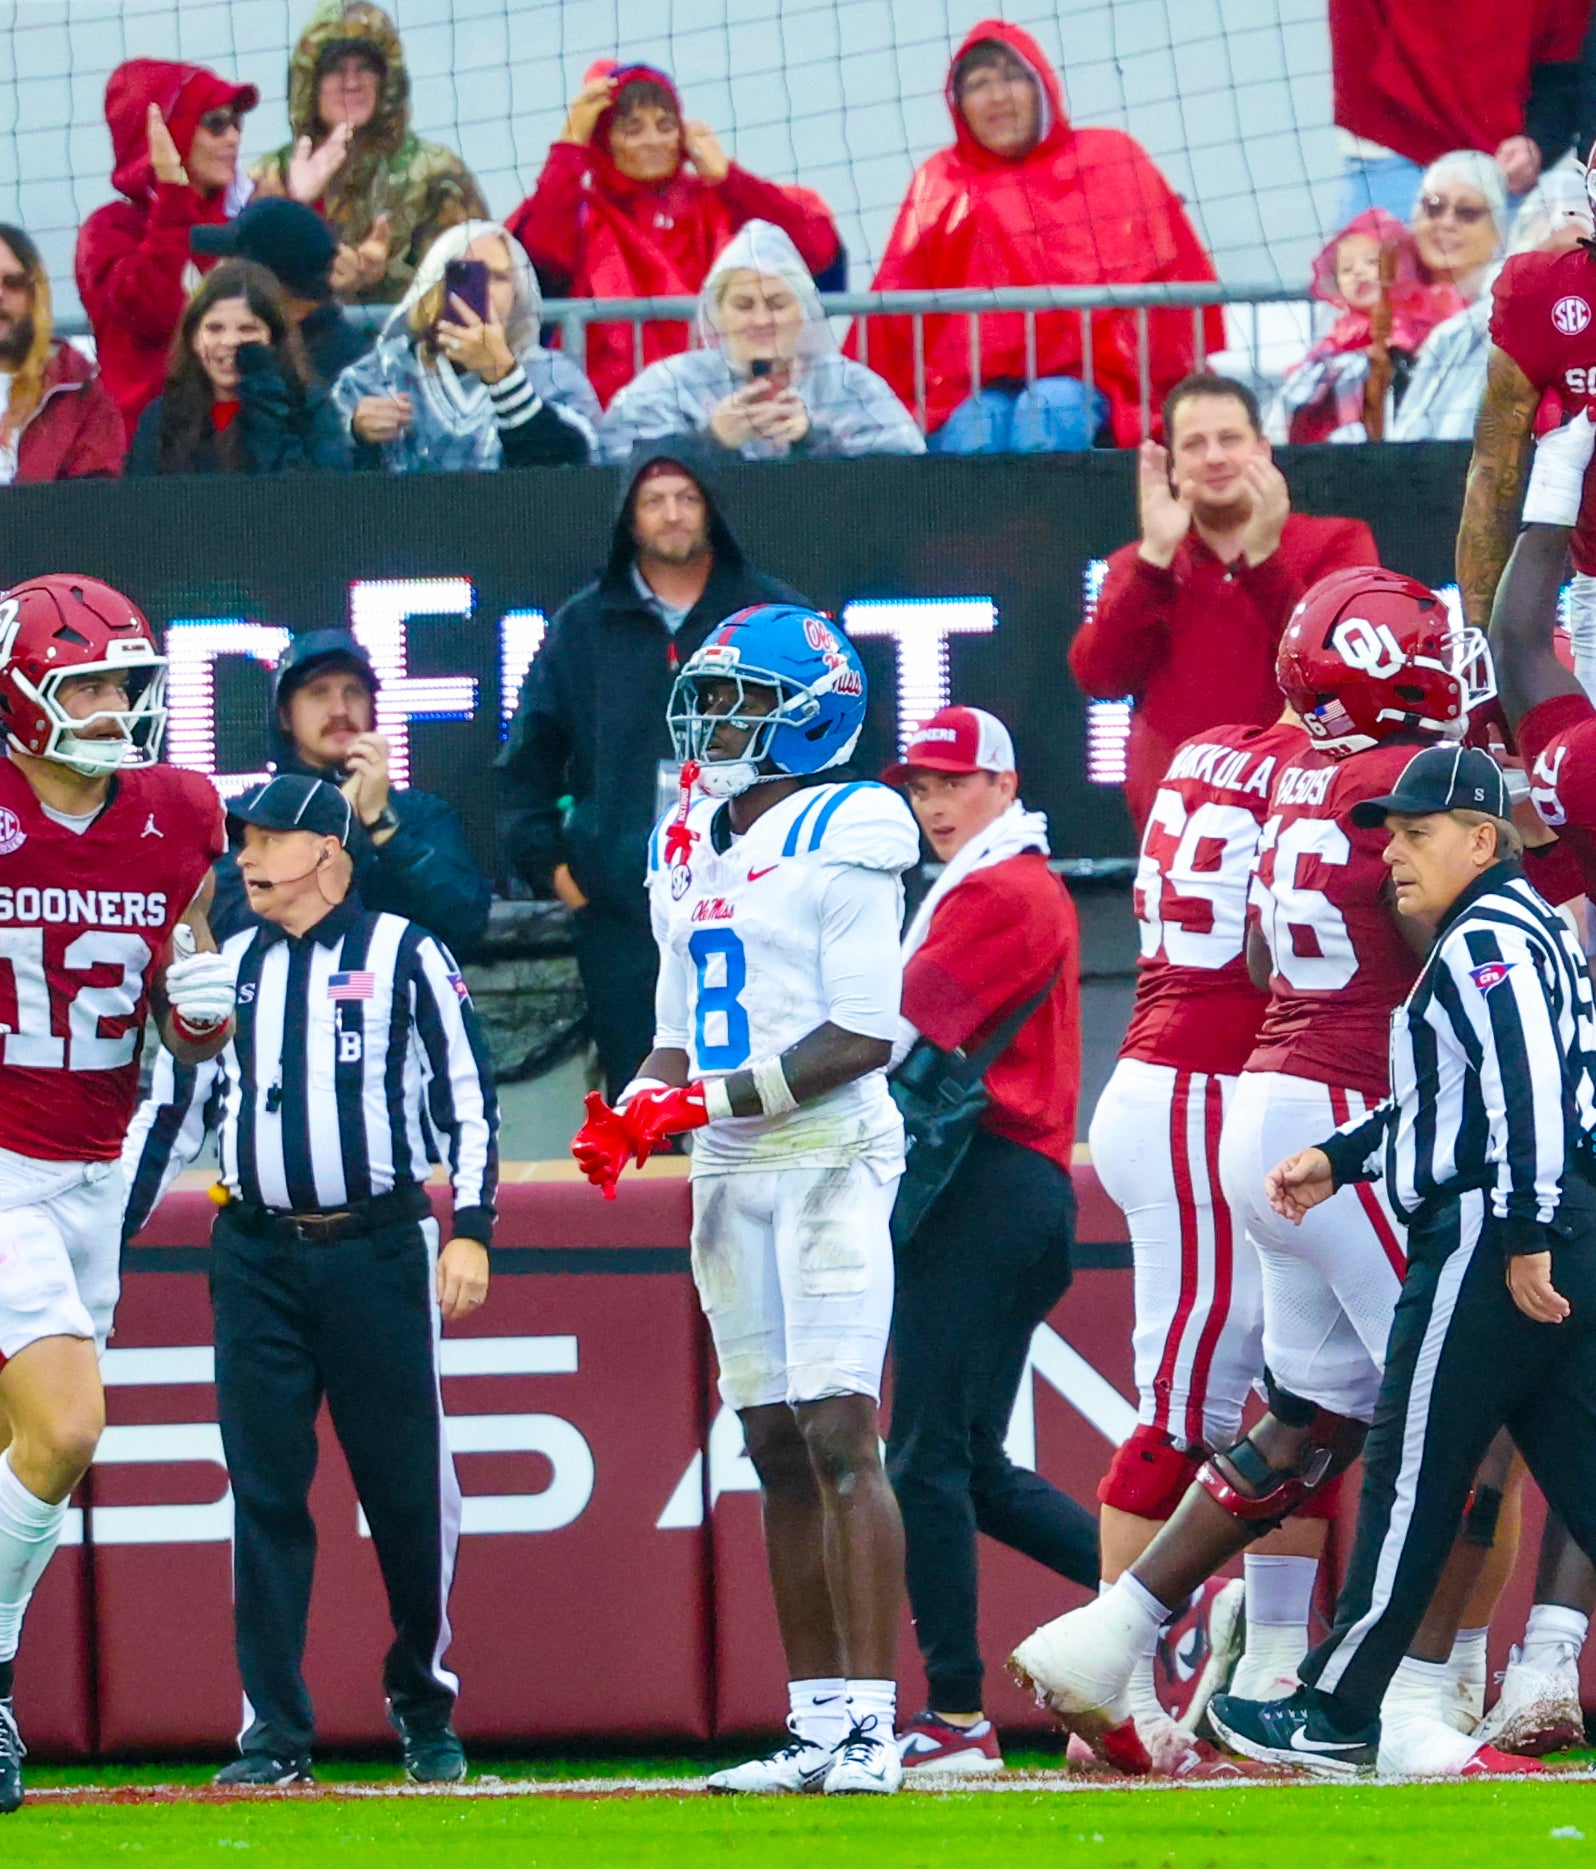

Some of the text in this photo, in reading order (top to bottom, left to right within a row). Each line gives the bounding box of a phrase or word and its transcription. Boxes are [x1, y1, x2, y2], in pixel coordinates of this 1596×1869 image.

[1555, 299, 1588, 332] SEC
[1332, 617, 1406, 680] OU
[1474, 788, 1485, 801] S
[1134, 787, 1262, 970] 69
[1248, 813, 1360, 991] 56
[0, 886, 167, 926] SOONERS
[0, 927, 152, 1071] 12
[237, 982, 256, 1005] S
[688, 927, 751, 1071] 8
[338, 1031, 362, 1062] B
